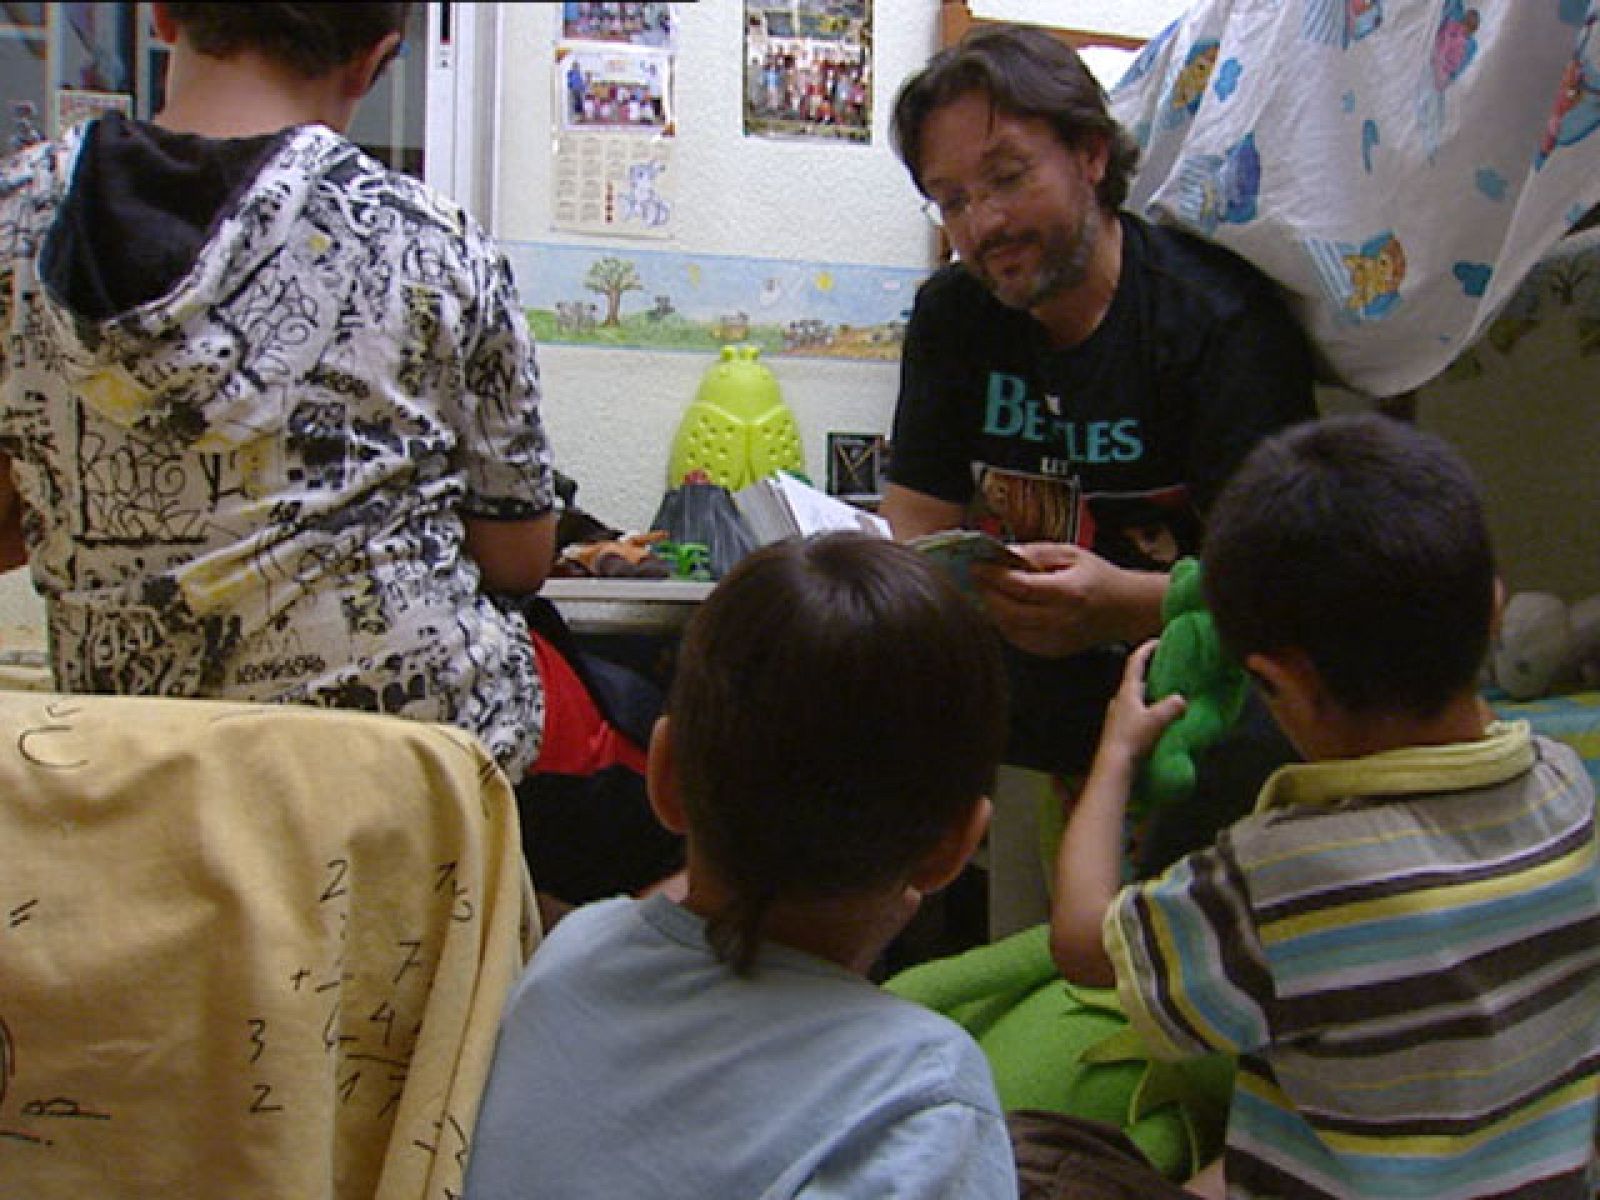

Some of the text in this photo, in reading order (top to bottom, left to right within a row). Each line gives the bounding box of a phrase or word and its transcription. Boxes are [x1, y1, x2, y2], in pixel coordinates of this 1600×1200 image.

[392, 940, 421, 985] 7
[247, 1019, 266, 1064] 3
[249, 1084, 284, 1114] 2
